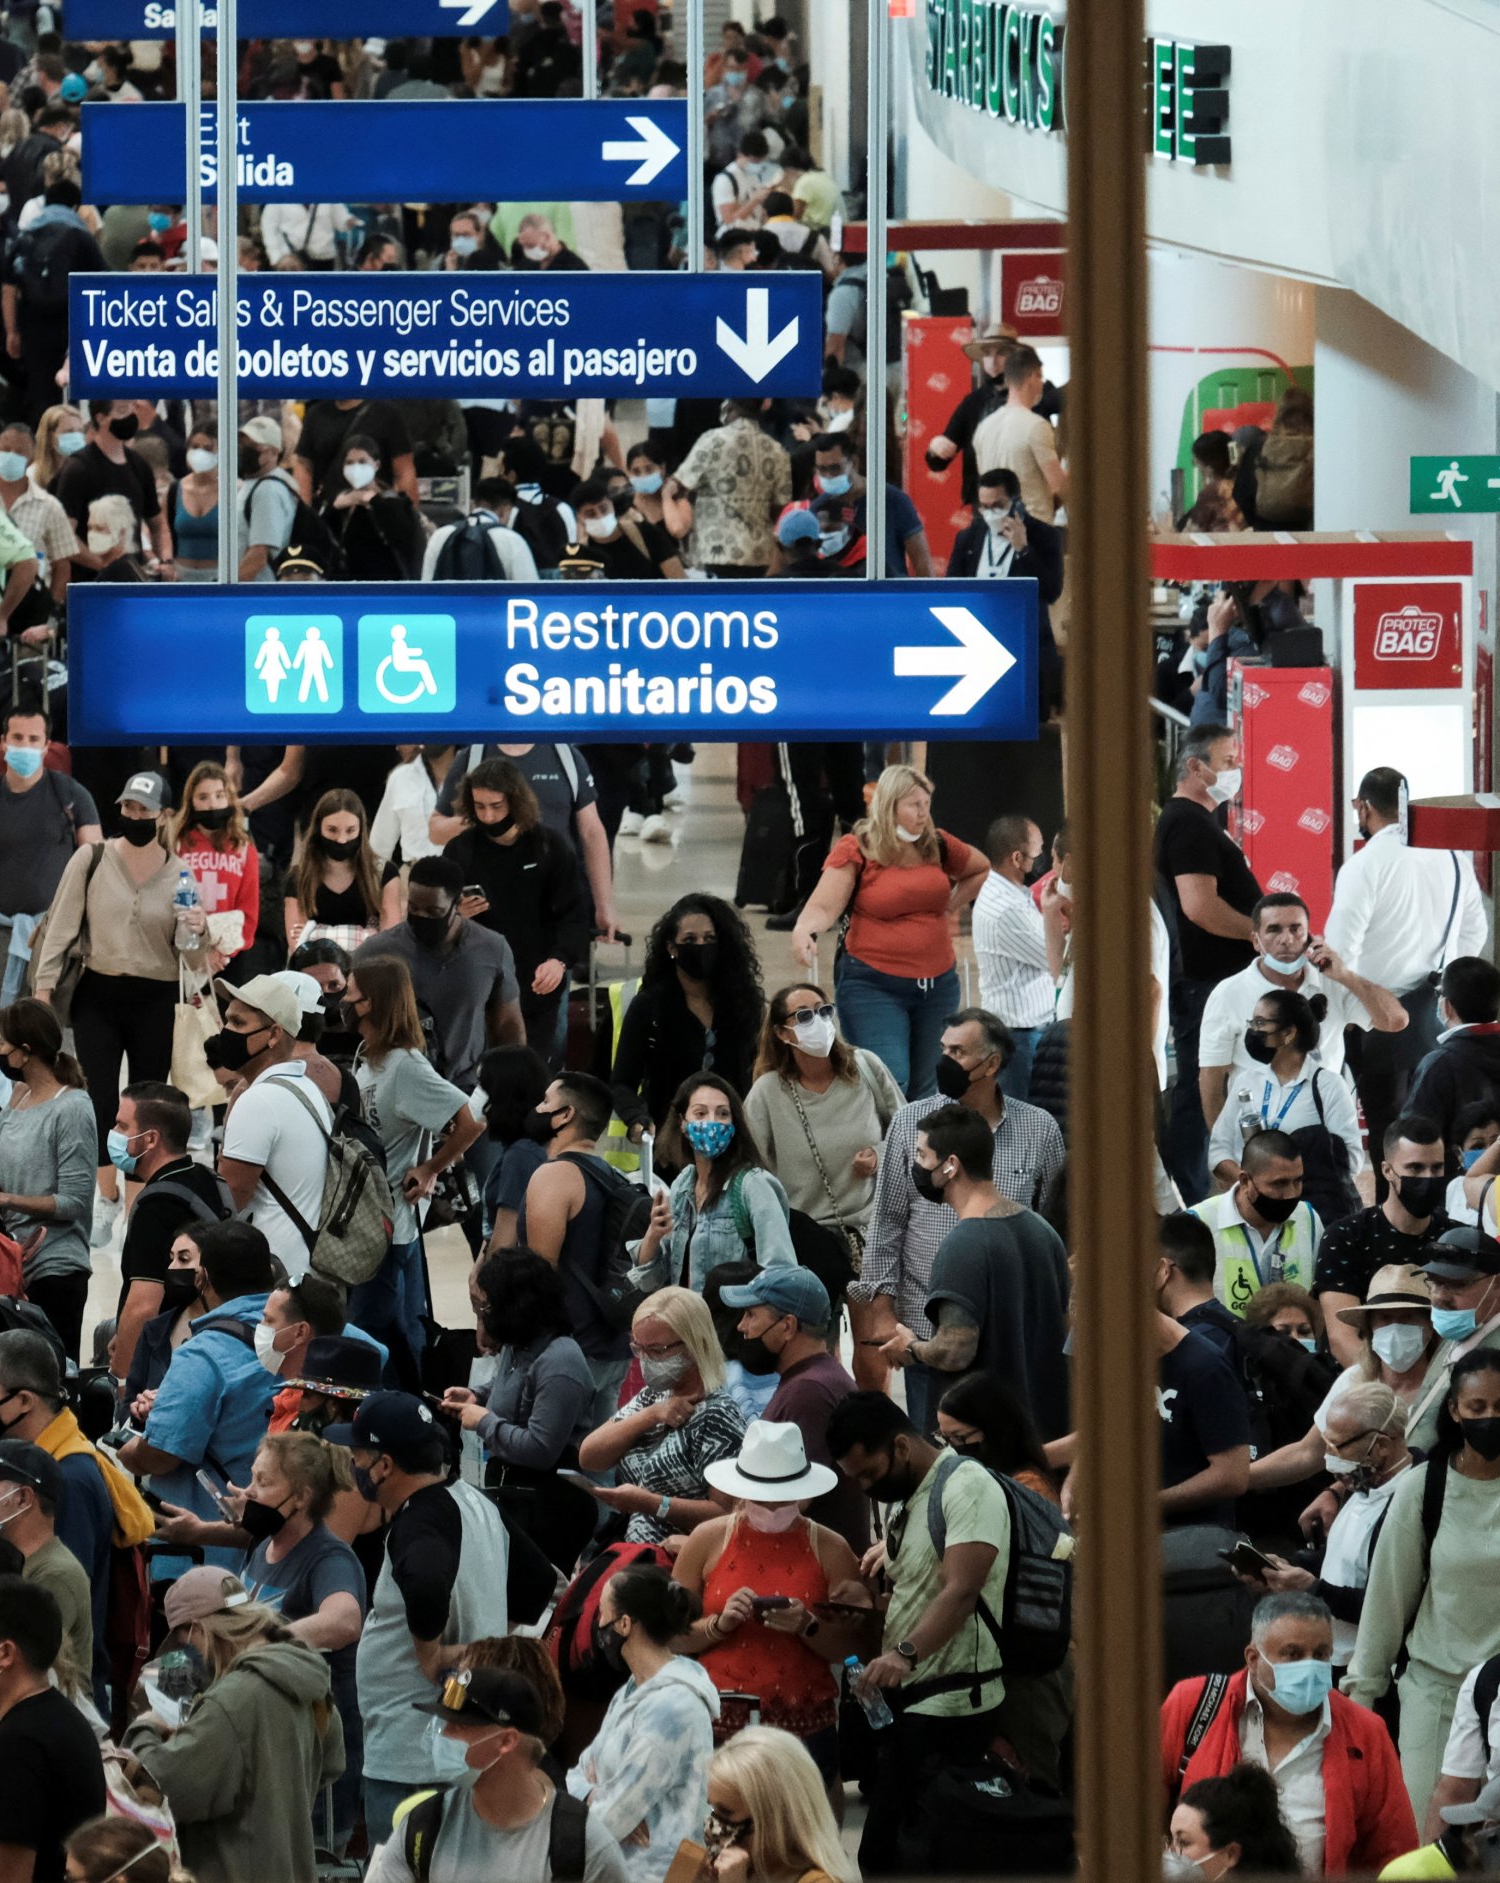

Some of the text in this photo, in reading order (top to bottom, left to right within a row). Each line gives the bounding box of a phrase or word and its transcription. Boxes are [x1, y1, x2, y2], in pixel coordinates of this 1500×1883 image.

[926, 0, 1054, 132] STARBUCKS
[199, 153, 295, 188] Slida
[82, 288, 571, 336] Ticket Sals & Passenger Services
[1020, 294, 1059, 312] BAG
[82, 338, 698, 387] Venta de boletos y servicios al pasajero
[506, 598, 780, 650] Restrooms
[1379, 631, 1435, 654] BAG
[1383, 618, 1437, 632] PROTEC
[503, 662, 779, 716] Sanitarios
[1200, 1687, 1219, 1722] MICHAEL
